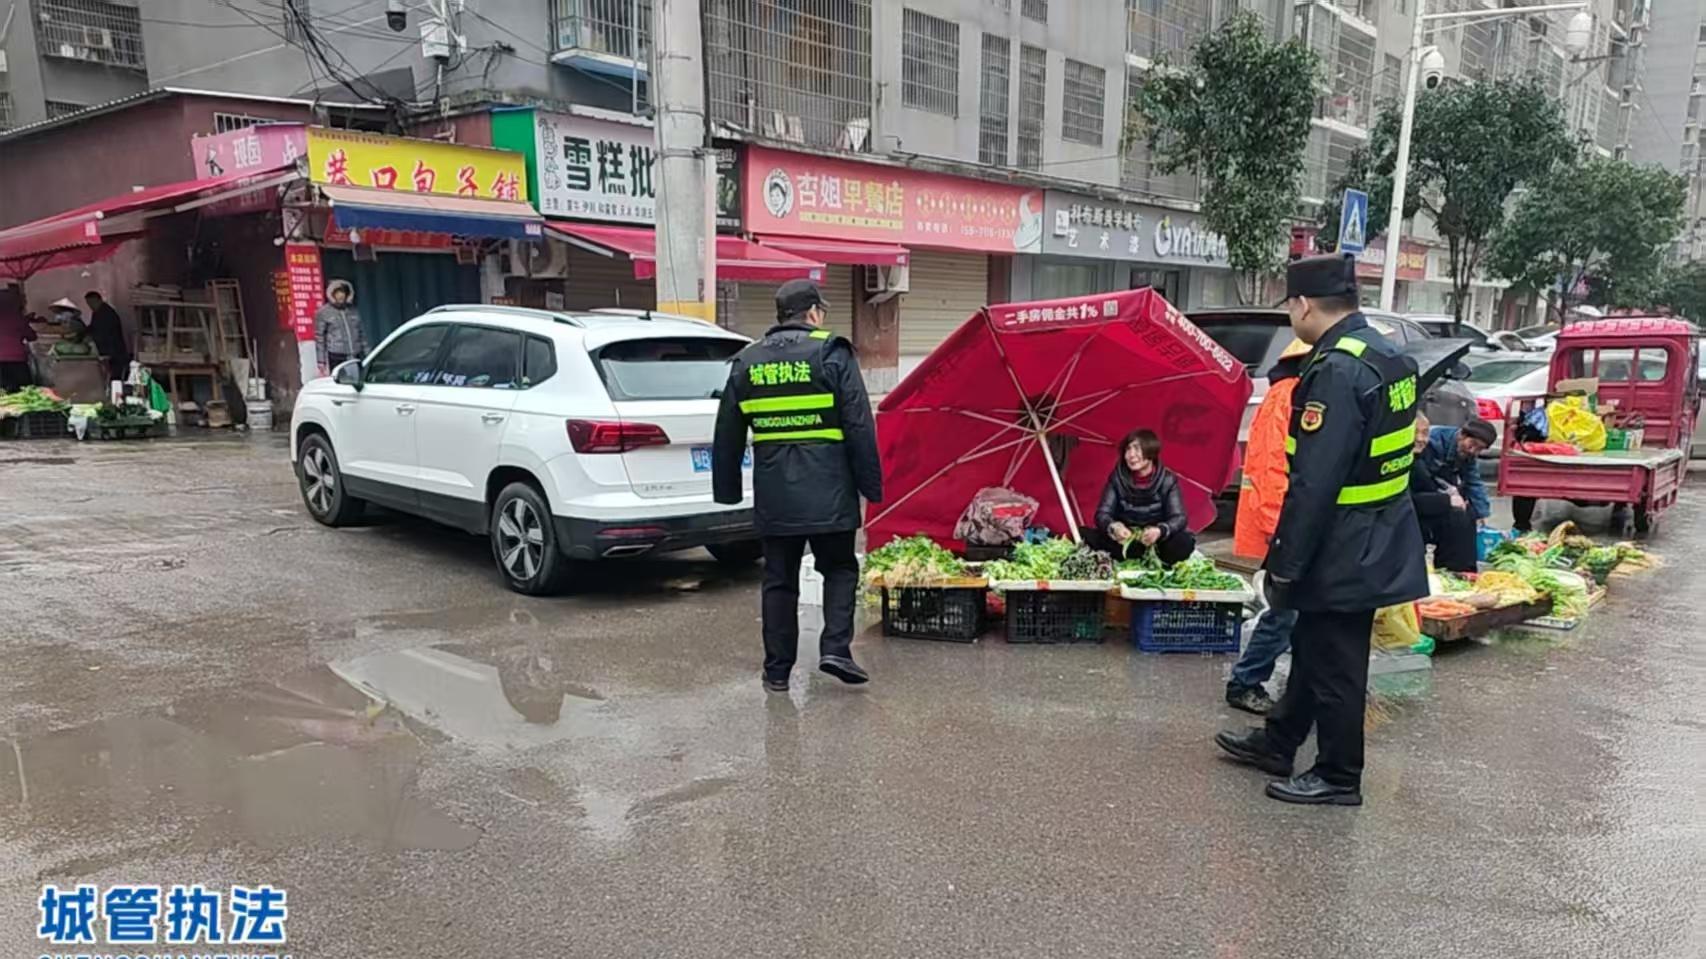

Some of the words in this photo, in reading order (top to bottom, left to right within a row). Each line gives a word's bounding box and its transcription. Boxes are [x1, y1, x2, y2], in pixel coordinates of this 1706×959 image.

[326, 149, 521, 201] 巷口包子铺
[564, 136, 656, 199] 雪糕批
[796, 172, 904, 217] 杏姐早餐店
[1004, 303, 1099, 326] 二手房佣金共1%
[749, 360, 811, 386] 城管执法
